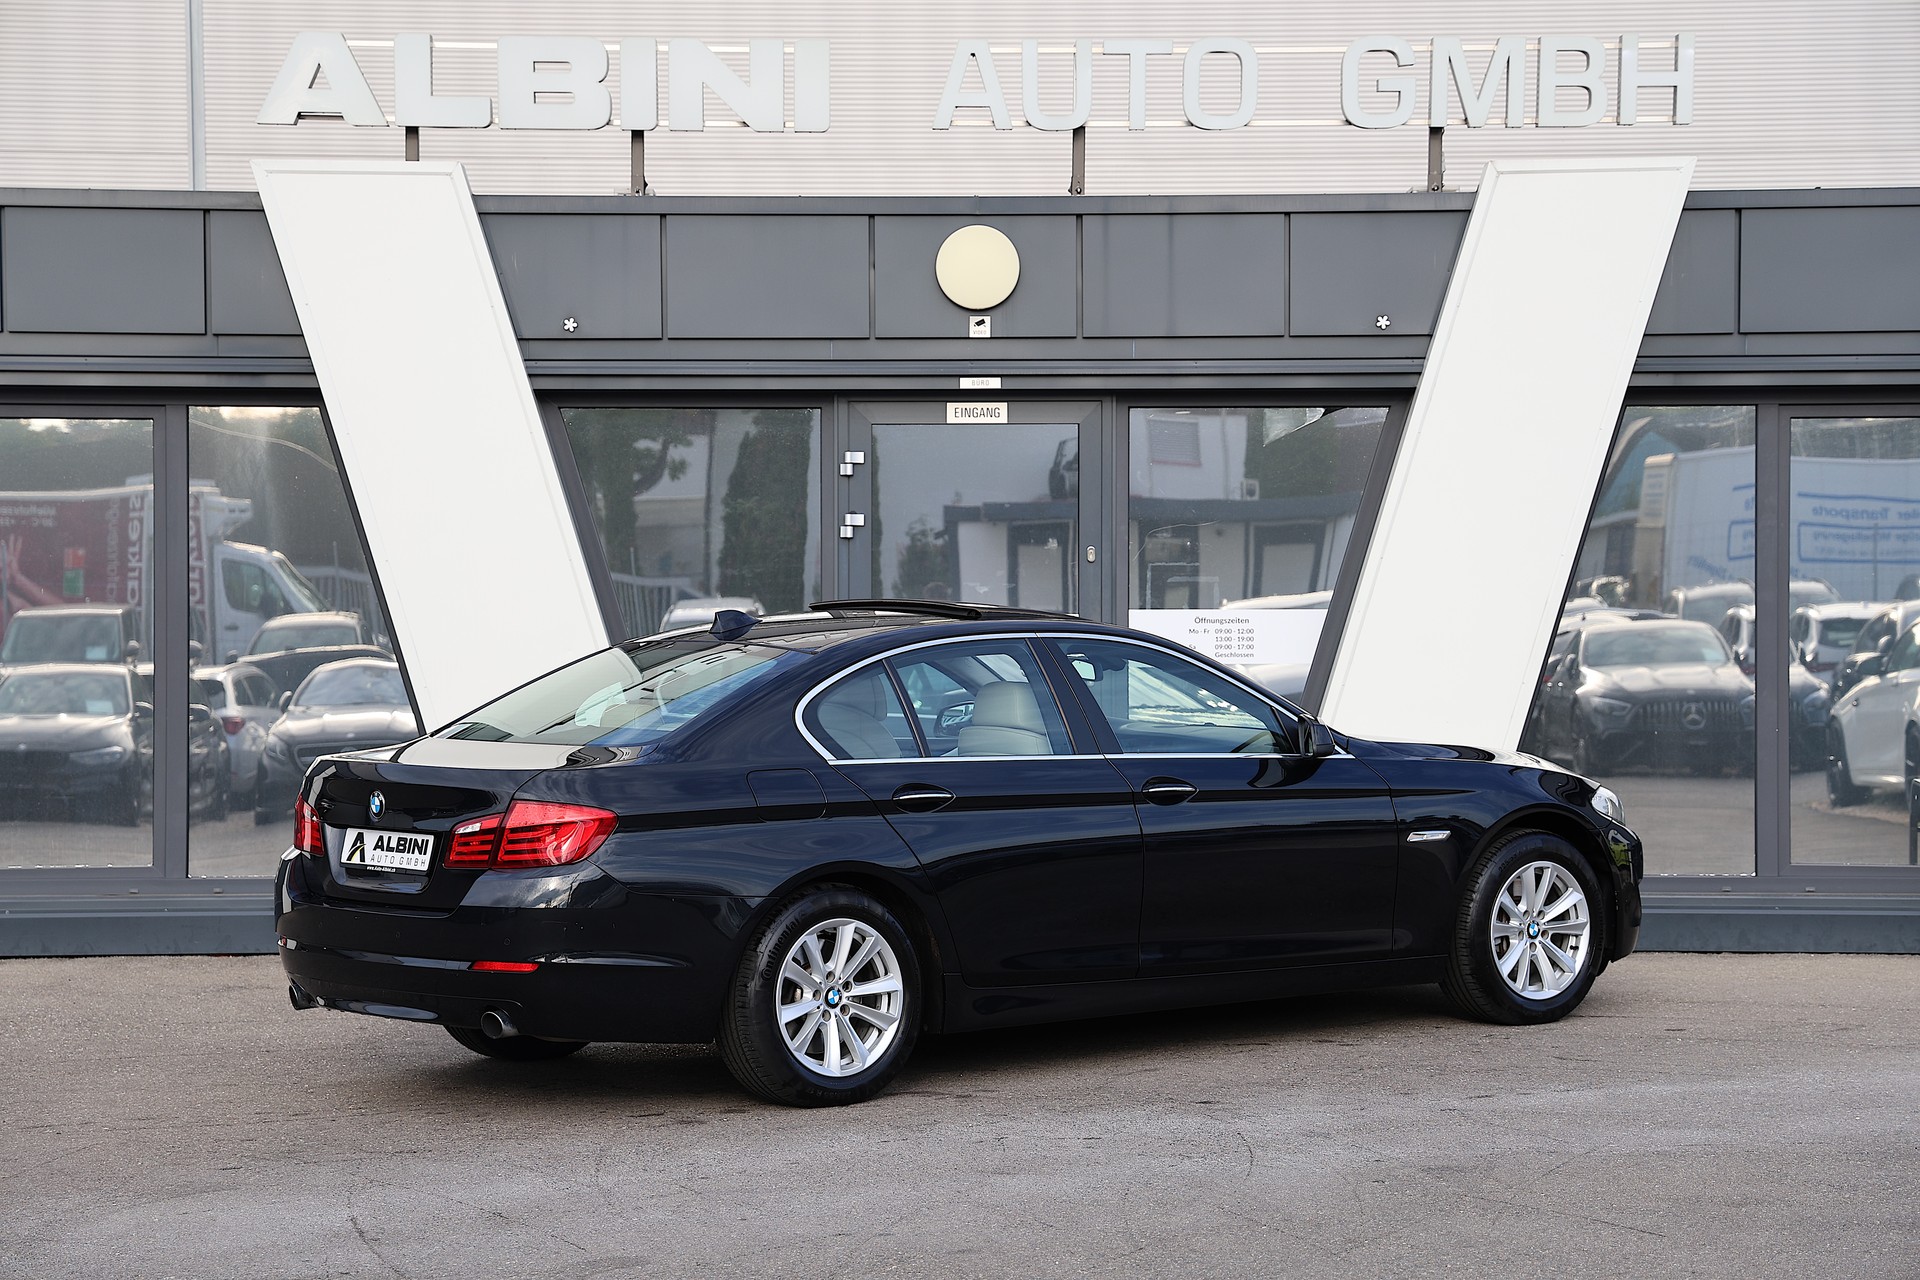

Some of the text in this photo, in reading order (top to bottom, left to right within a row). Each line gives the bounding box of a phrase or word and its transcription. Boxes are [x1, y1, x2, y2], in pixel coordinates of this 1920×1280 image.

[257, 32, 1696, 133] ALBINI AUTO GMBH
[954, 407, 1000, 418] EINGANG
[373, 835, 429, 855] ALBINI
[370, 854, 426, 866] AUTO GMBH
